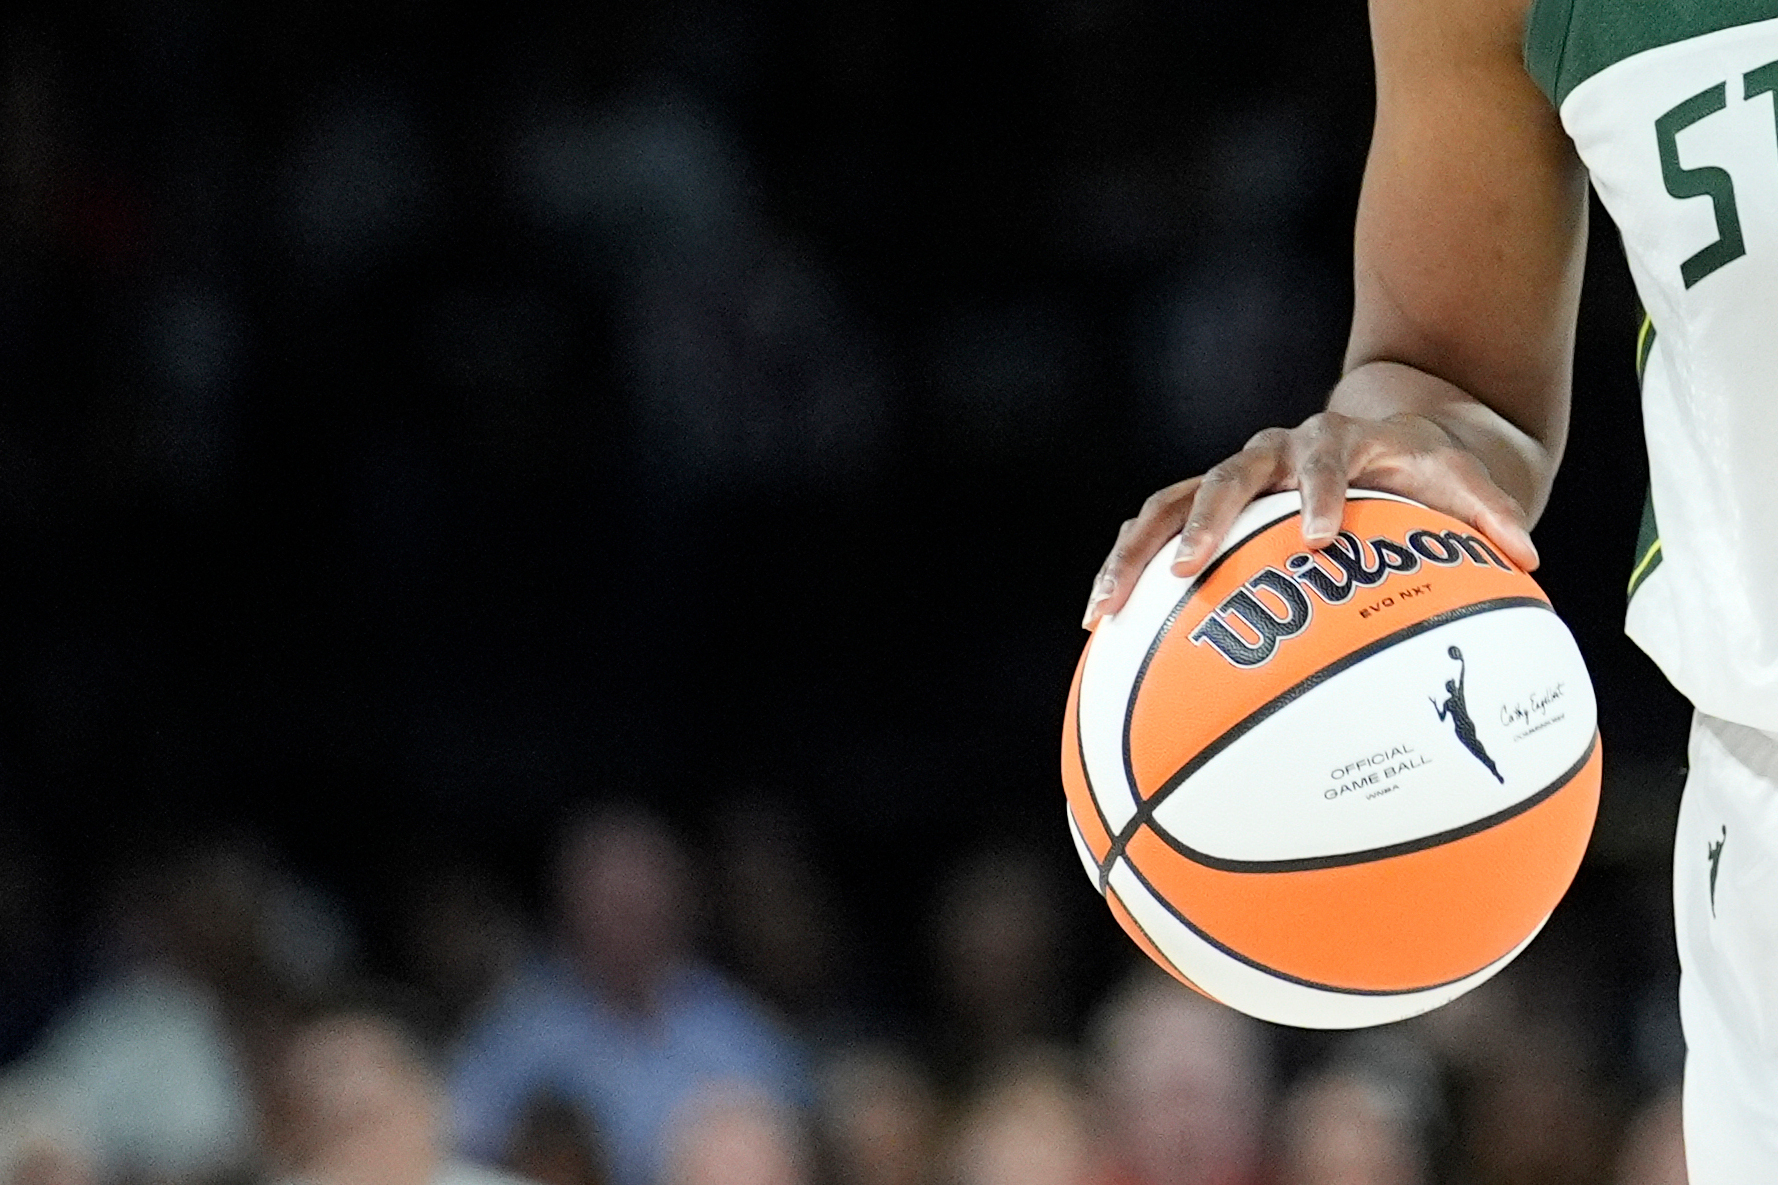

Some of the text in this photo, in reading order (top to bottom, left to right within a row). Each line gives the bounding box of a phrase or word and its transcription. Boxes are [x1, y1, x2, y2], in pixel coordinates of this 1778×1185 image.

[1187, 529, 1515, 669] Wilson
[1359, 583, 1432, 619] EVO NXT
[1324, 755, 1433, 800] GAME BALL
[1330, 744, 1414, 780] OFFICIAL
